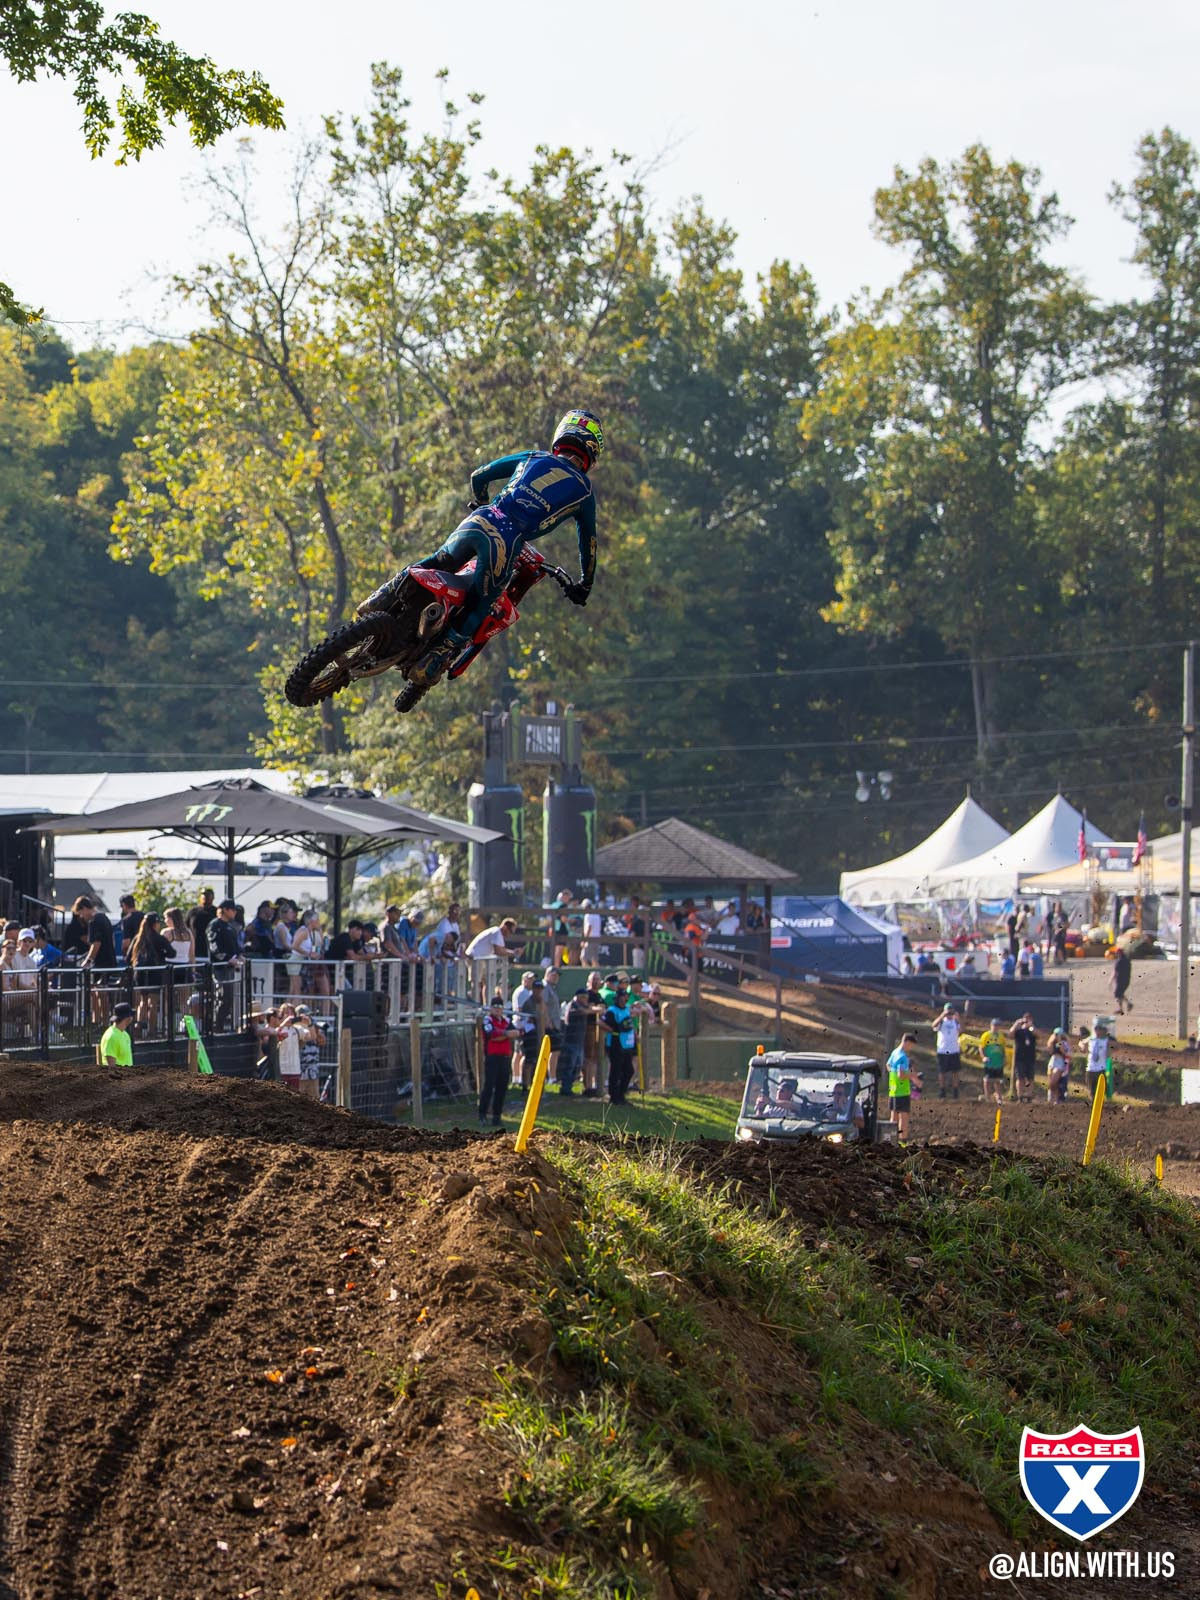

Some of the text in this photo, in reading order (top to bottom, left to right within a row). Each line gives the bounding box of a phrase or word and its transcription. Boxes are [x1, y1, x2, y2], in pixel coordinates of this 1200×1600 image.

[530, 467, 573, 493] 1
[519, 484, 551, 512] HONDA
[526, 725, 560, 753] FINISH
